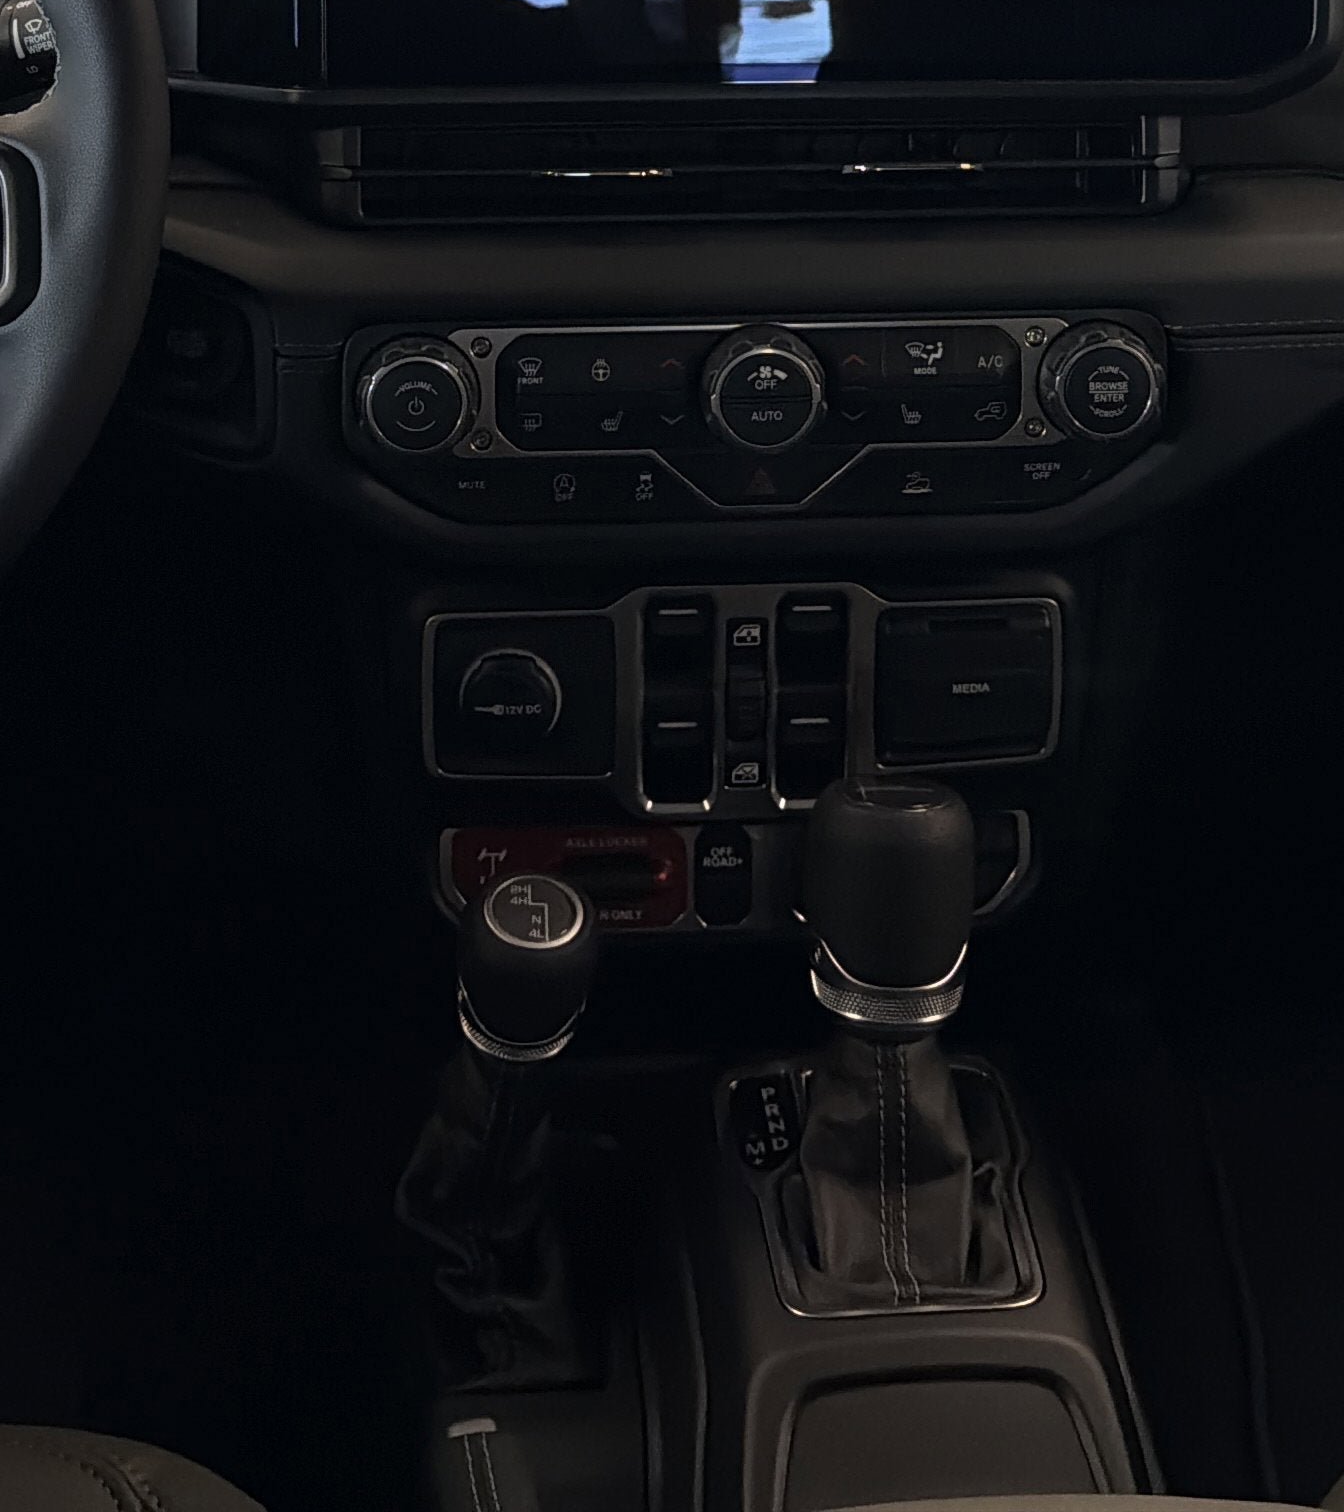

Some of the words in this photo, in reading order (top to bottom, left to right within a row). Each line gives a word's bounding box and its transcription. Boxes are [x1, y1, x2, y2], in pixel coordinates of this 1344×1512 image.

[23, 31, 52, 46] FRONT
[978, 354, 1003, 369] A/C
[913, 367, 938, 375] MODE
[517, 377, 544, 385] FRONT
[754, 379, 778, 390] OFF
[1088, 381, 1128, 390] BROWSE
[1094, 393, 1125, 403] ENTER
[751, 410, 783, 421] AUTO
[1023, 462, 1061, 471] SCREEN
[1031, 471, 1052, 480] OFF
[458, 481, 485, 489] MUTE
[951, 682, 991, 694] MEDIA
[505, 704, 524, 715] 12V
[525, 704, 543, 715] DC
[710, 846, 734, 857] OFF
[510, 896, 528, 905] 4H
[531, 914, 542, 925] N
[611, 908, 643, 921] ONLY
[528, 928, 545, 939] 4L
[760, 1086, 776, 1102] P
[764, 1103, 781, 1117] R
[768, 1116, 786, 1134] N
[745, 1140, 766, 1157] M
[771, 1137, 789, 1152] D
